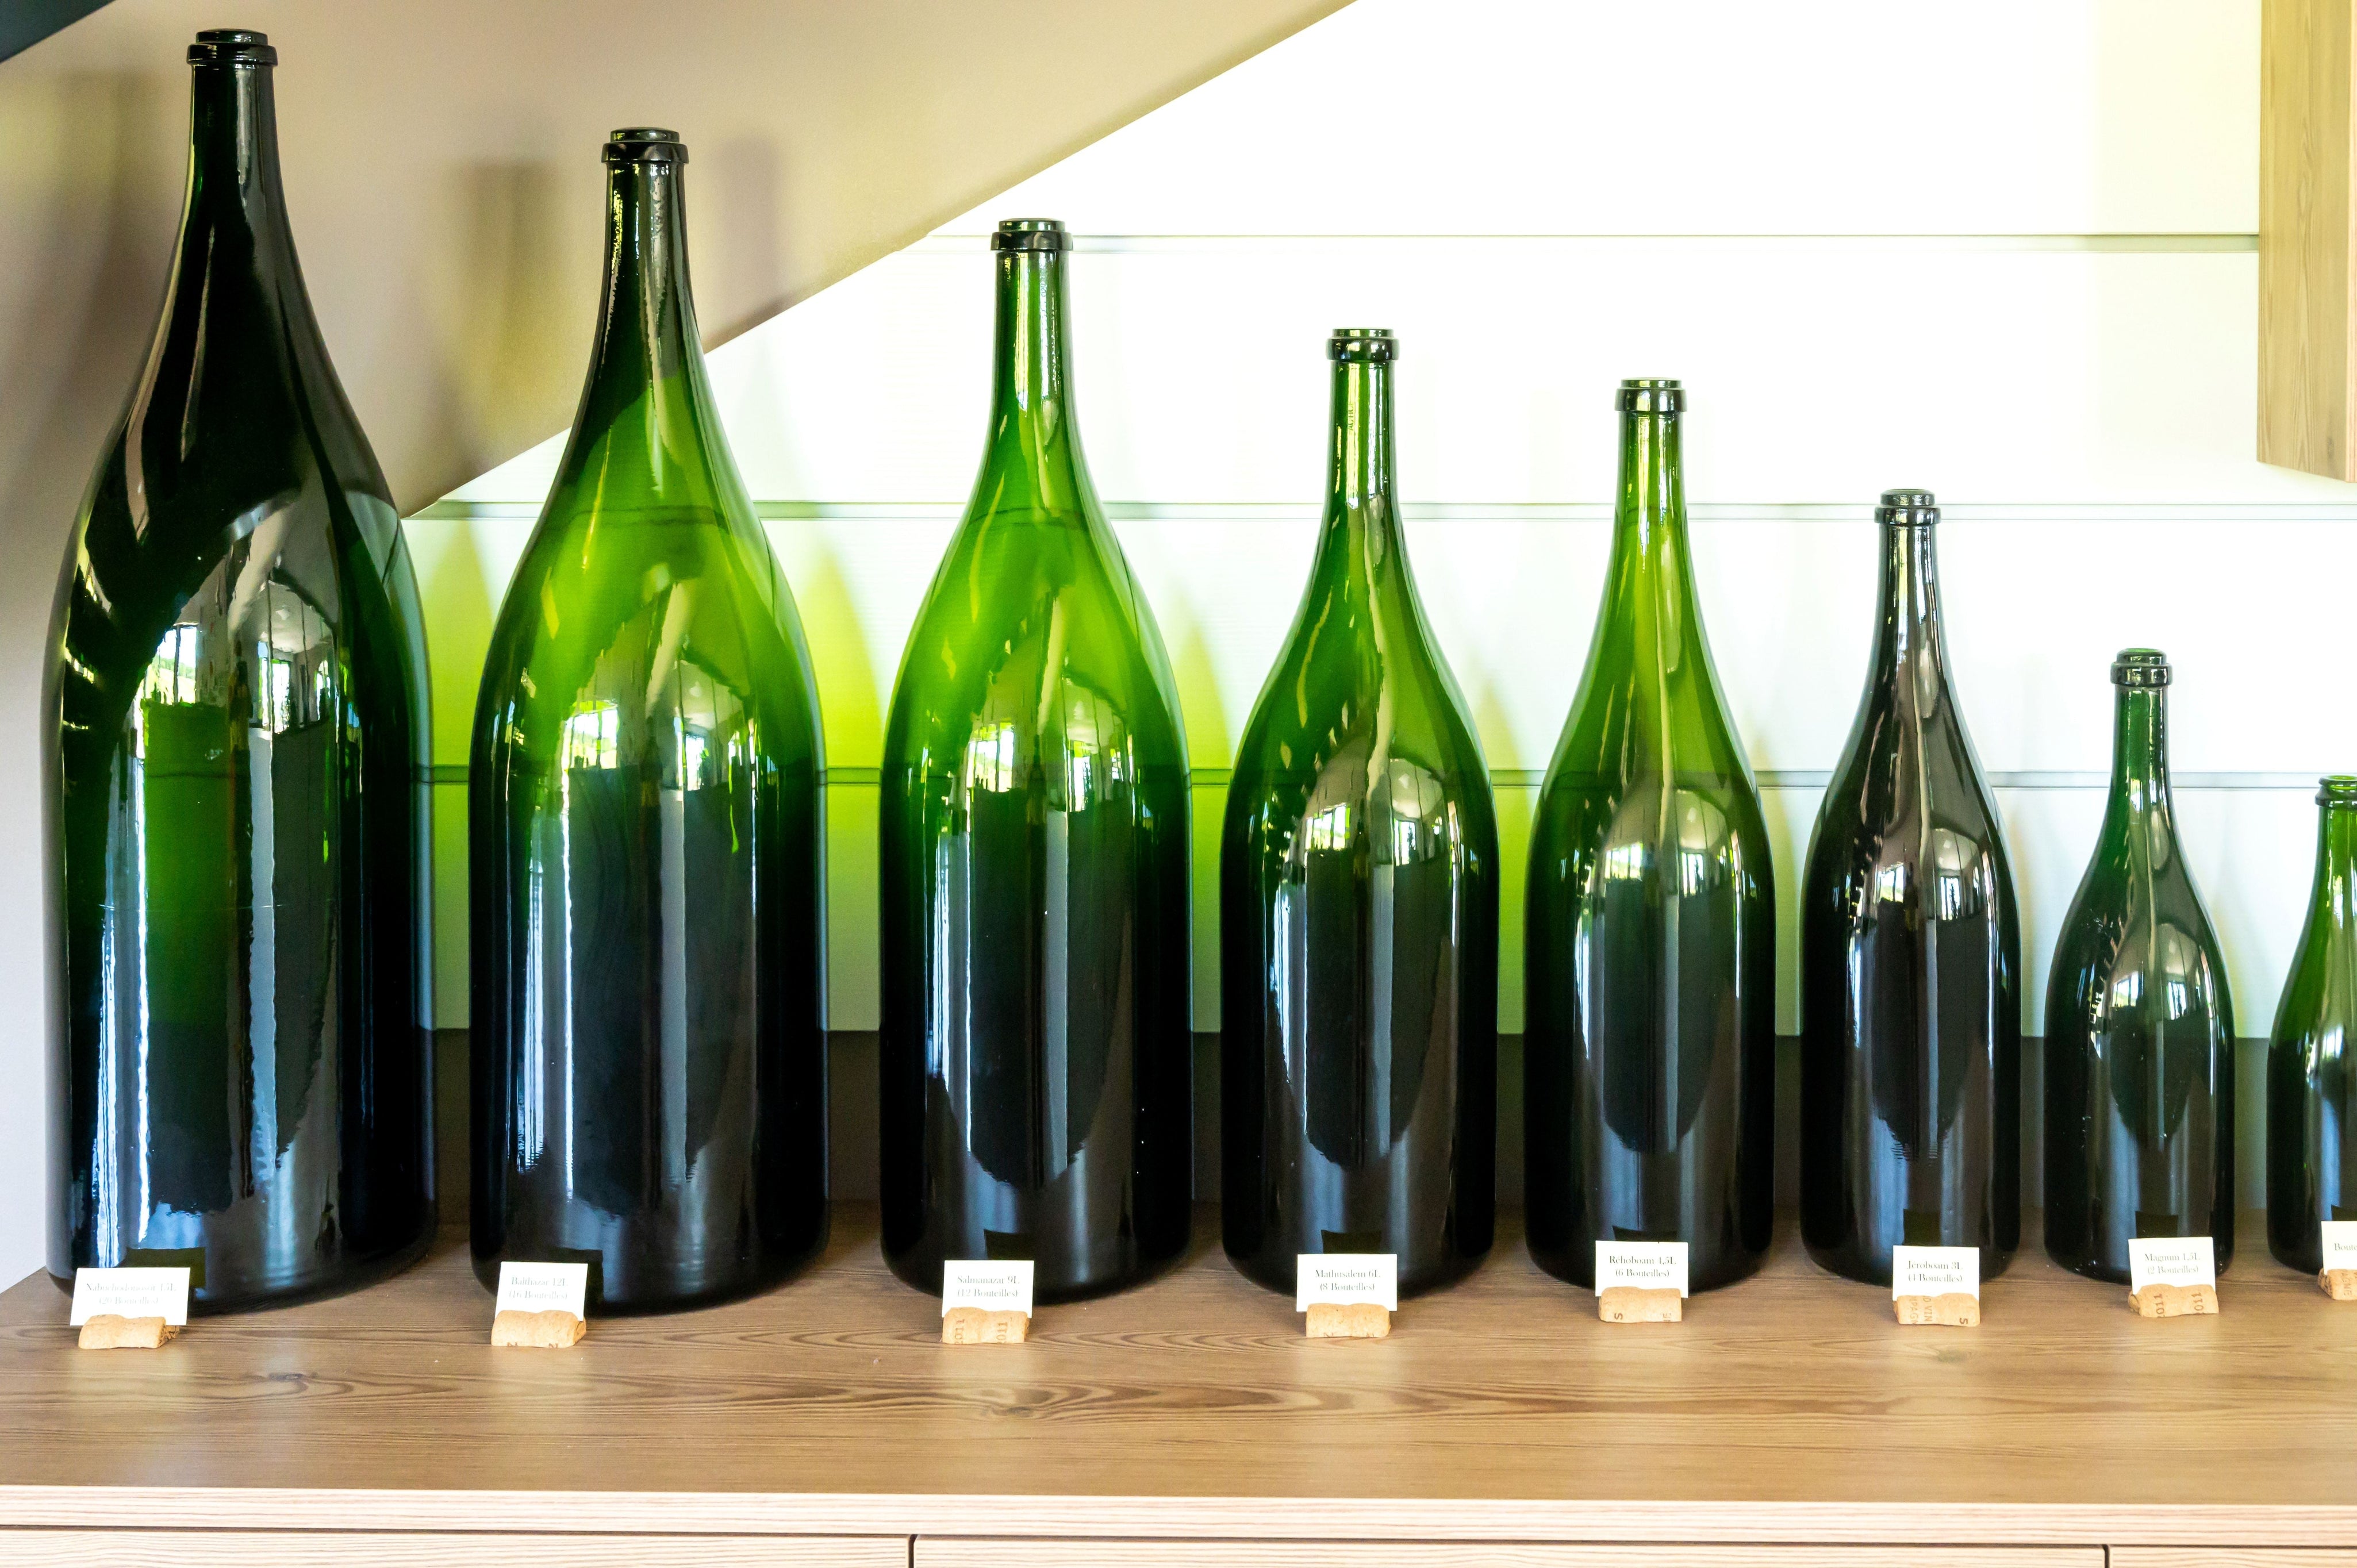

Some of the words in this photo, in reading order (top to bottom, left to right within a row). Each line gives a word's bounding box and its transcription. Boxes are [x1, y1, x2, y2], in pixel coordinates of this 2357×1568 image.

[2144, 1252, 2181, 1262] Magnum
[1315, 1269, 1366, 1278] Mathusalem
[1615, 1268, 1624, 1277] (6
[1626, 1268, 1670, 1277] Bouteilles)
[2147, 1265, 2155, 1275] (2
[2158, 1265, 2199, 1274] Bouteilles)
[511, 1277, 548, 1286] Balthazar
[957, 1275, 1005, 1284] Salmanazar
[1919, 1273, 1963, 1282] Bouteilles)
[1319, 1282, 1329, 1292] (8
[1331, 1282, 1375, 1292] Bouteilles)
[524, 1290, 568, 1300] Bouteilles)
[957, 1288, 972, 1297] (12
[974, 1288, 1019, 1297] Bouteilles)
[2153, 1293, 2165, 1317] 011
[2191, 1293, 2204, 1314] 011
[1924, 1305, 1933, 1322] VIN
[996, 1322, 1008, 1344] 011
